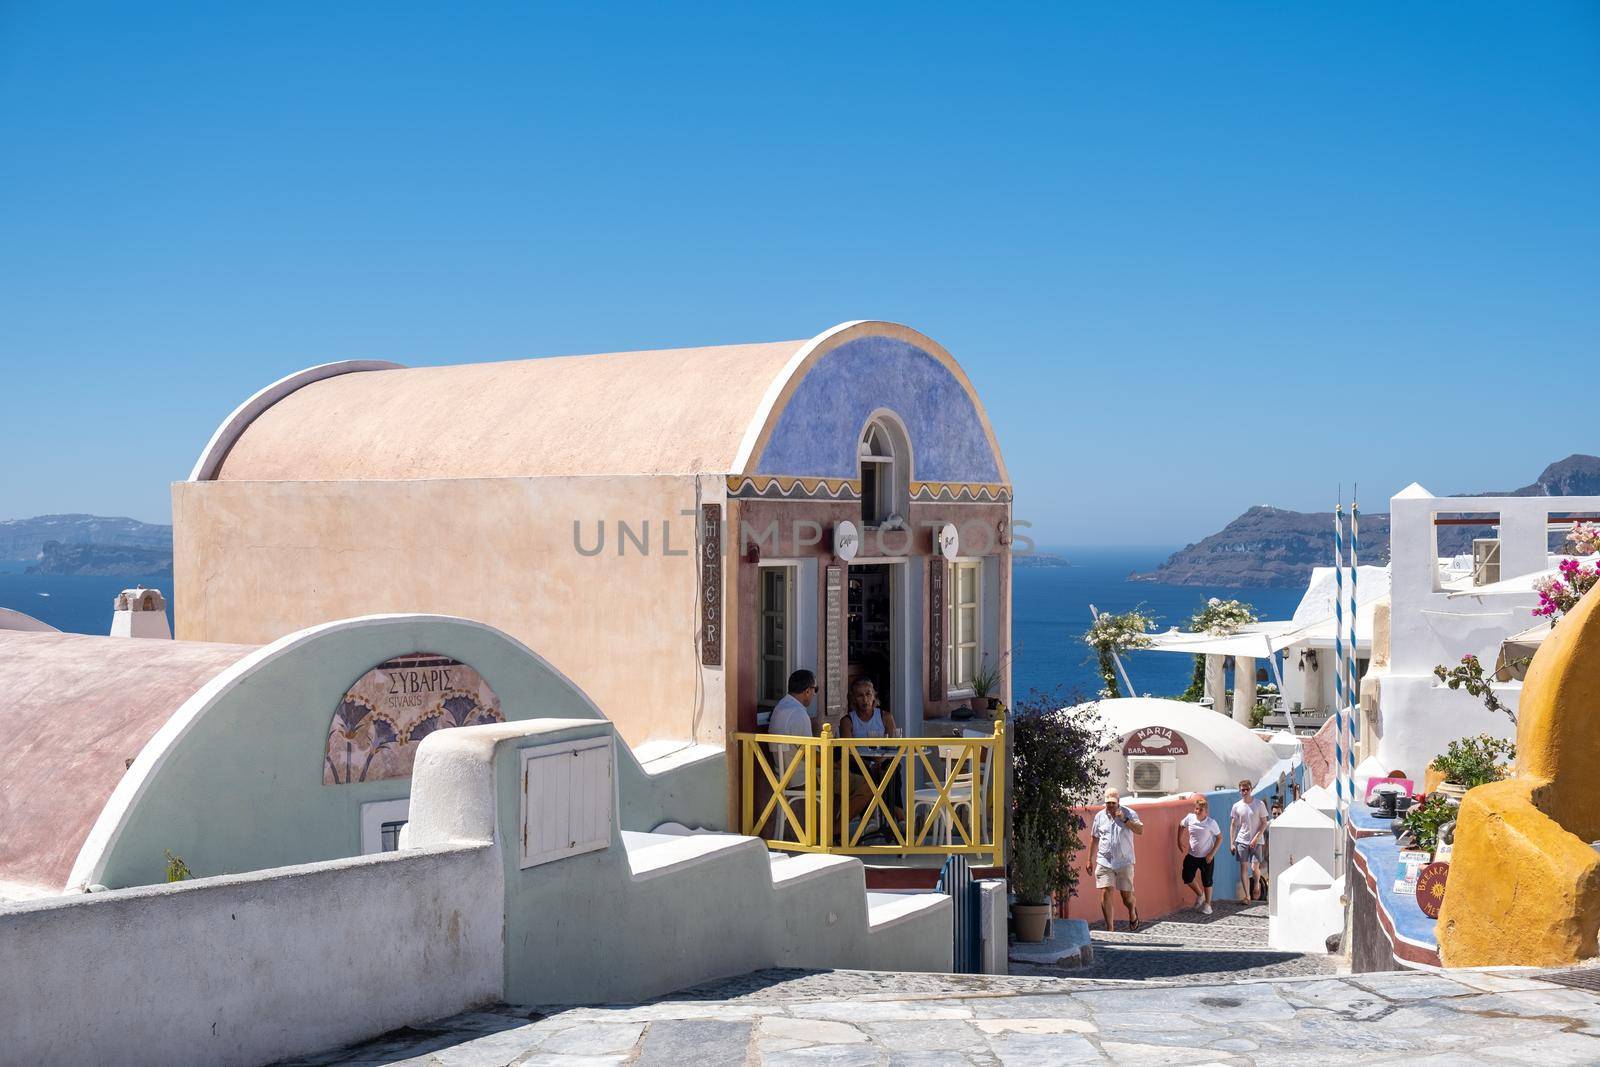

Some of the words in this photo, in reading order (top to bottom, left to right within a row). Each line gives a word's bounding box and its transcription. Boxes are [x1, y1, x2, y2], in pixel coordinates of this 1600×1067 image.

[388, 669, 453, 694] ΣΥΒΑΡΙΣ
[388, 695, 423, 708] SIVARIS
[1137, 726, 1173, 740] MARIA
